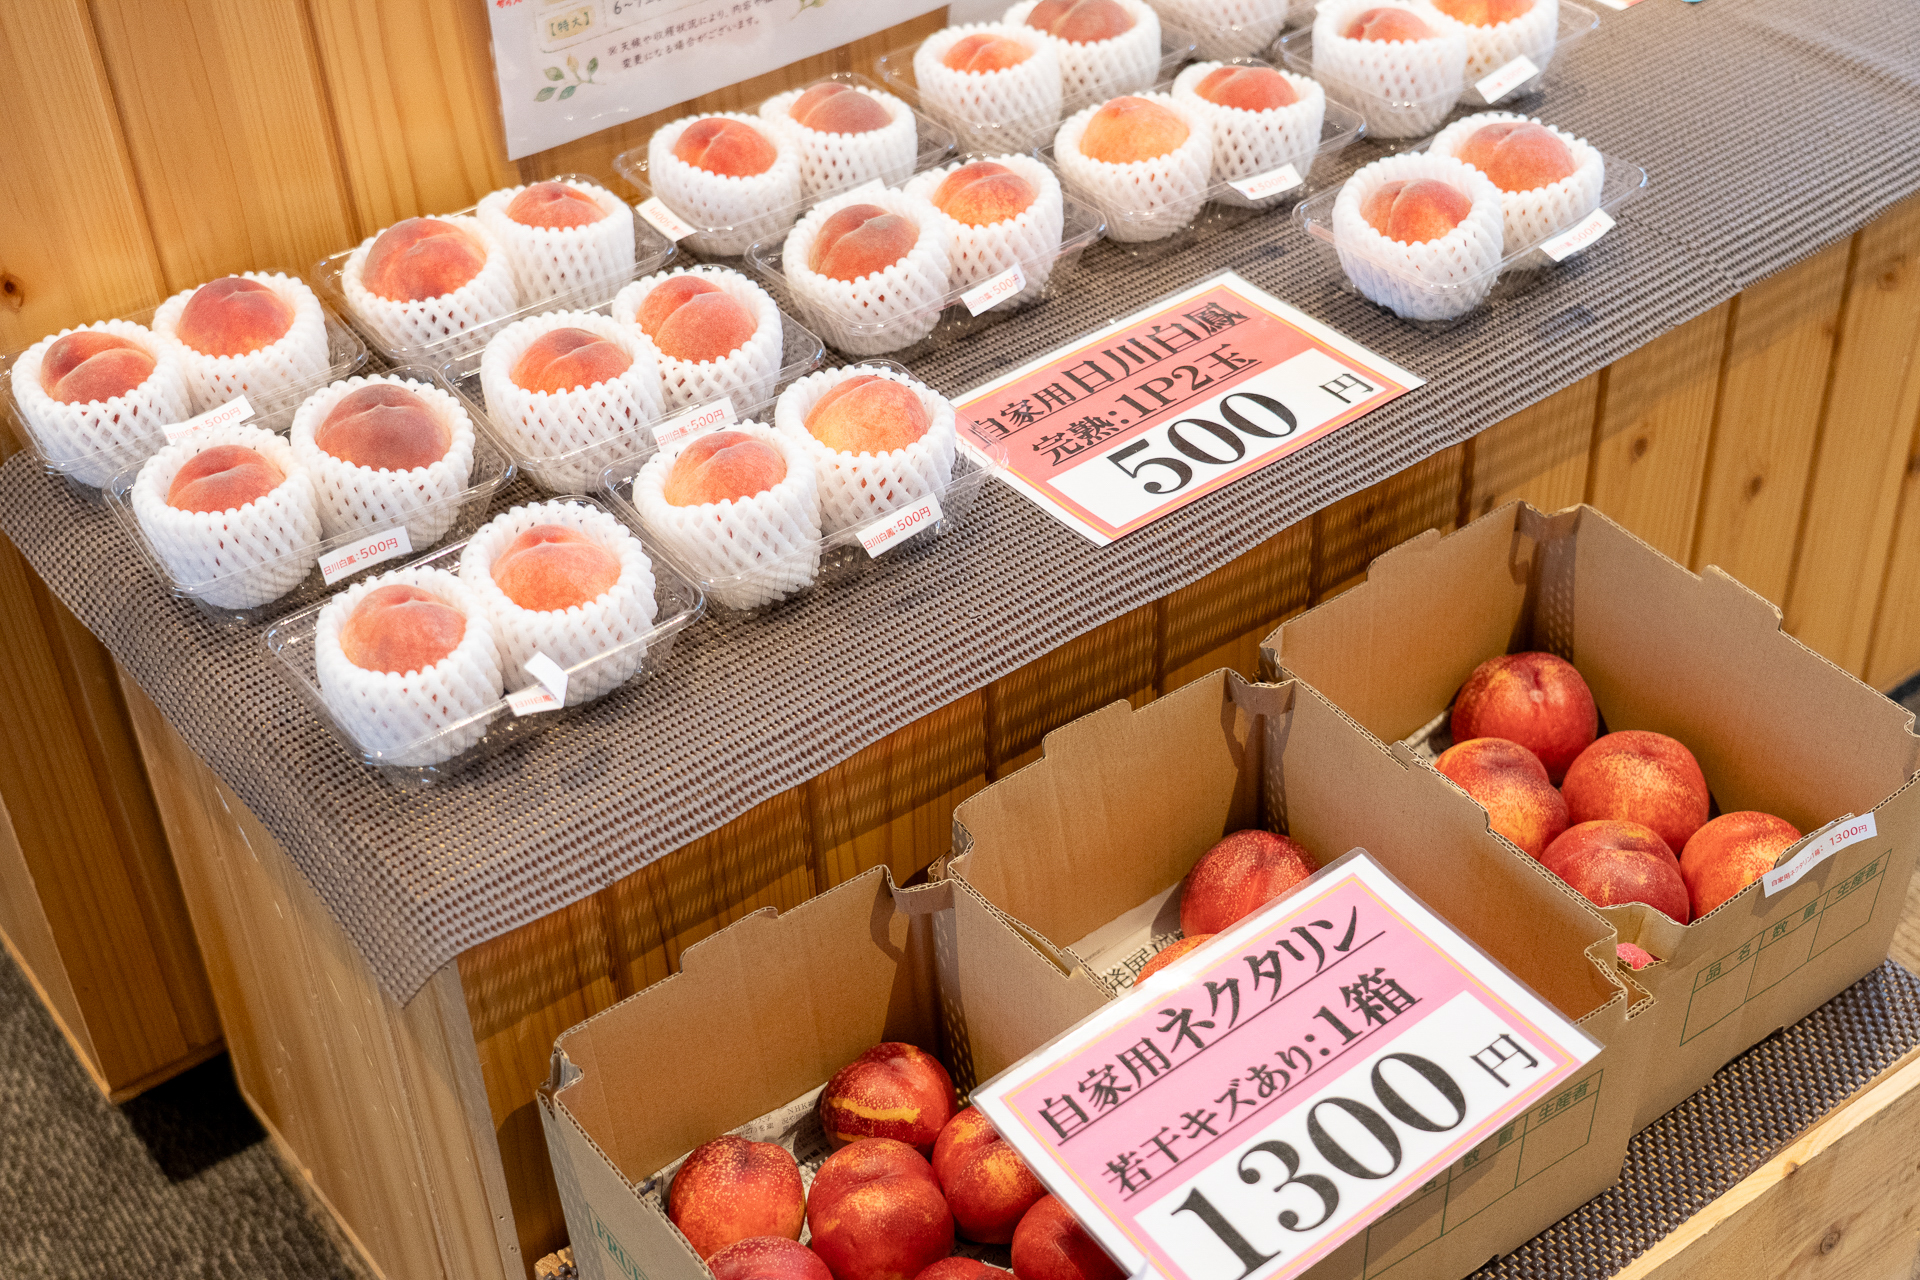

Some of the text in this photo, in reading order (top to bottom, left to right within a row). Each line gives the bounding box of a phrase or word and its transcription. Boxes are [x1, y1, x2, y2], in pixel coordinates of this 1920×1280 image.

[550, 11, 590, 37] 【特大】
[608, 0, 773, 56] ※天候や収穫状況により、内容や
[974, 302, 1251, 438] 自家用日川白鳳
[1106, 372, 1374, 494] 500 円
[1038, 906, 1358, 1140] 自家用ネクタリン
[1170, 1034, 1539, 1280] 1300 円
